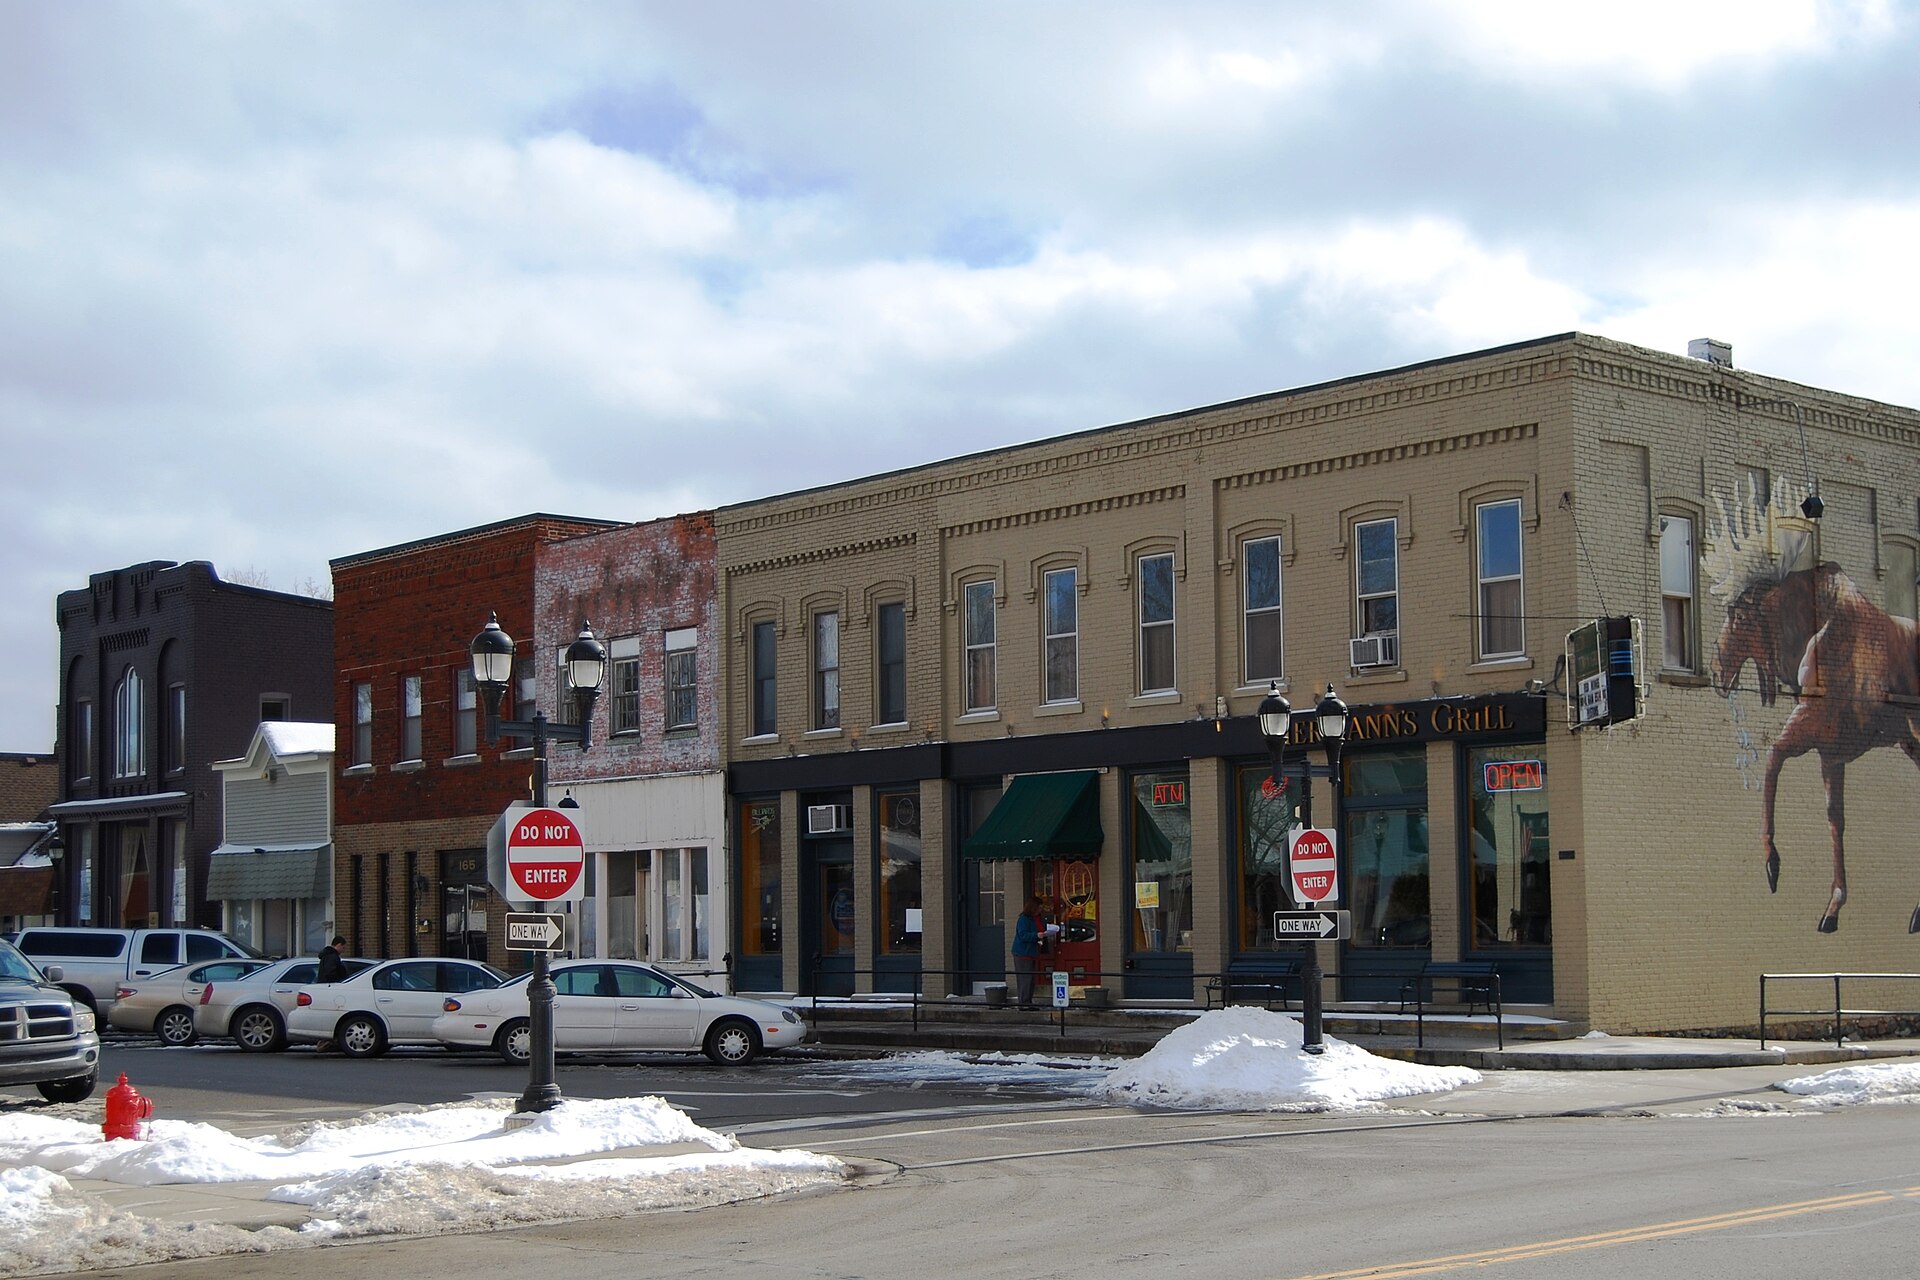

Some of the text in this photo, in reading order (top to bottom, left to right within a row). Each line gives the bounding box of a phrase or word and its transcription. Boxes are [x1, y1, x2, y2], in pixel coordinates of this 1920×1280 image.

[1486, 763, 1541, 790] OPEN
[1153, 783, 1183, 804] ATM
[520, 825, 571, 840] DO NOT
[1298, 842, 1328, 855] DO NOT
[459, 860, 476, 871] 165
[525, 869, 568, 884] ENTER
[1302, 876, 1328, 889] ENTER
[511, 924, 549, 940] ONE WAY
[1281, 920, 1321, 932] ONE WAY
